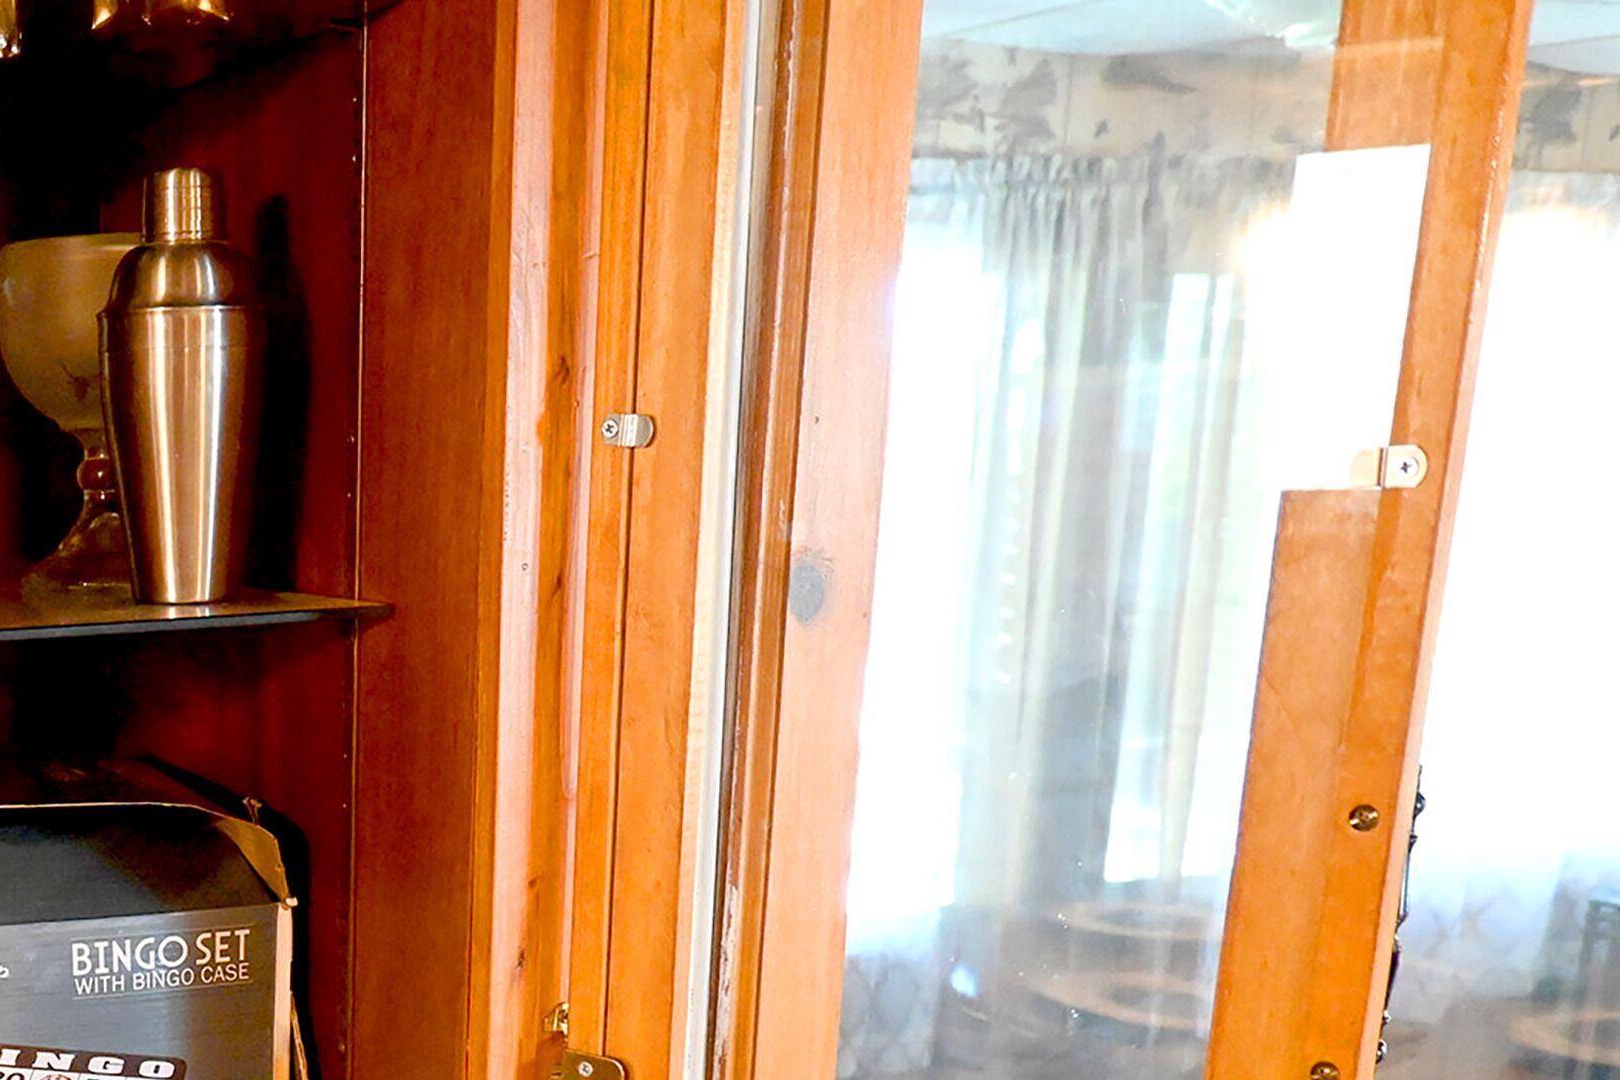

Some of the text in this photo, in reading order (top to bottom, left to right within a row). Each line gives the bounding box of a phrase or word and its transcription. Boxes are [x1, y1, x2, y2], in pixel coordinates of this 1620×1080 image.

[70, 928, 252, 976] BINGO SET
[74, 961, 250, 996] WITH BINGO CASE
